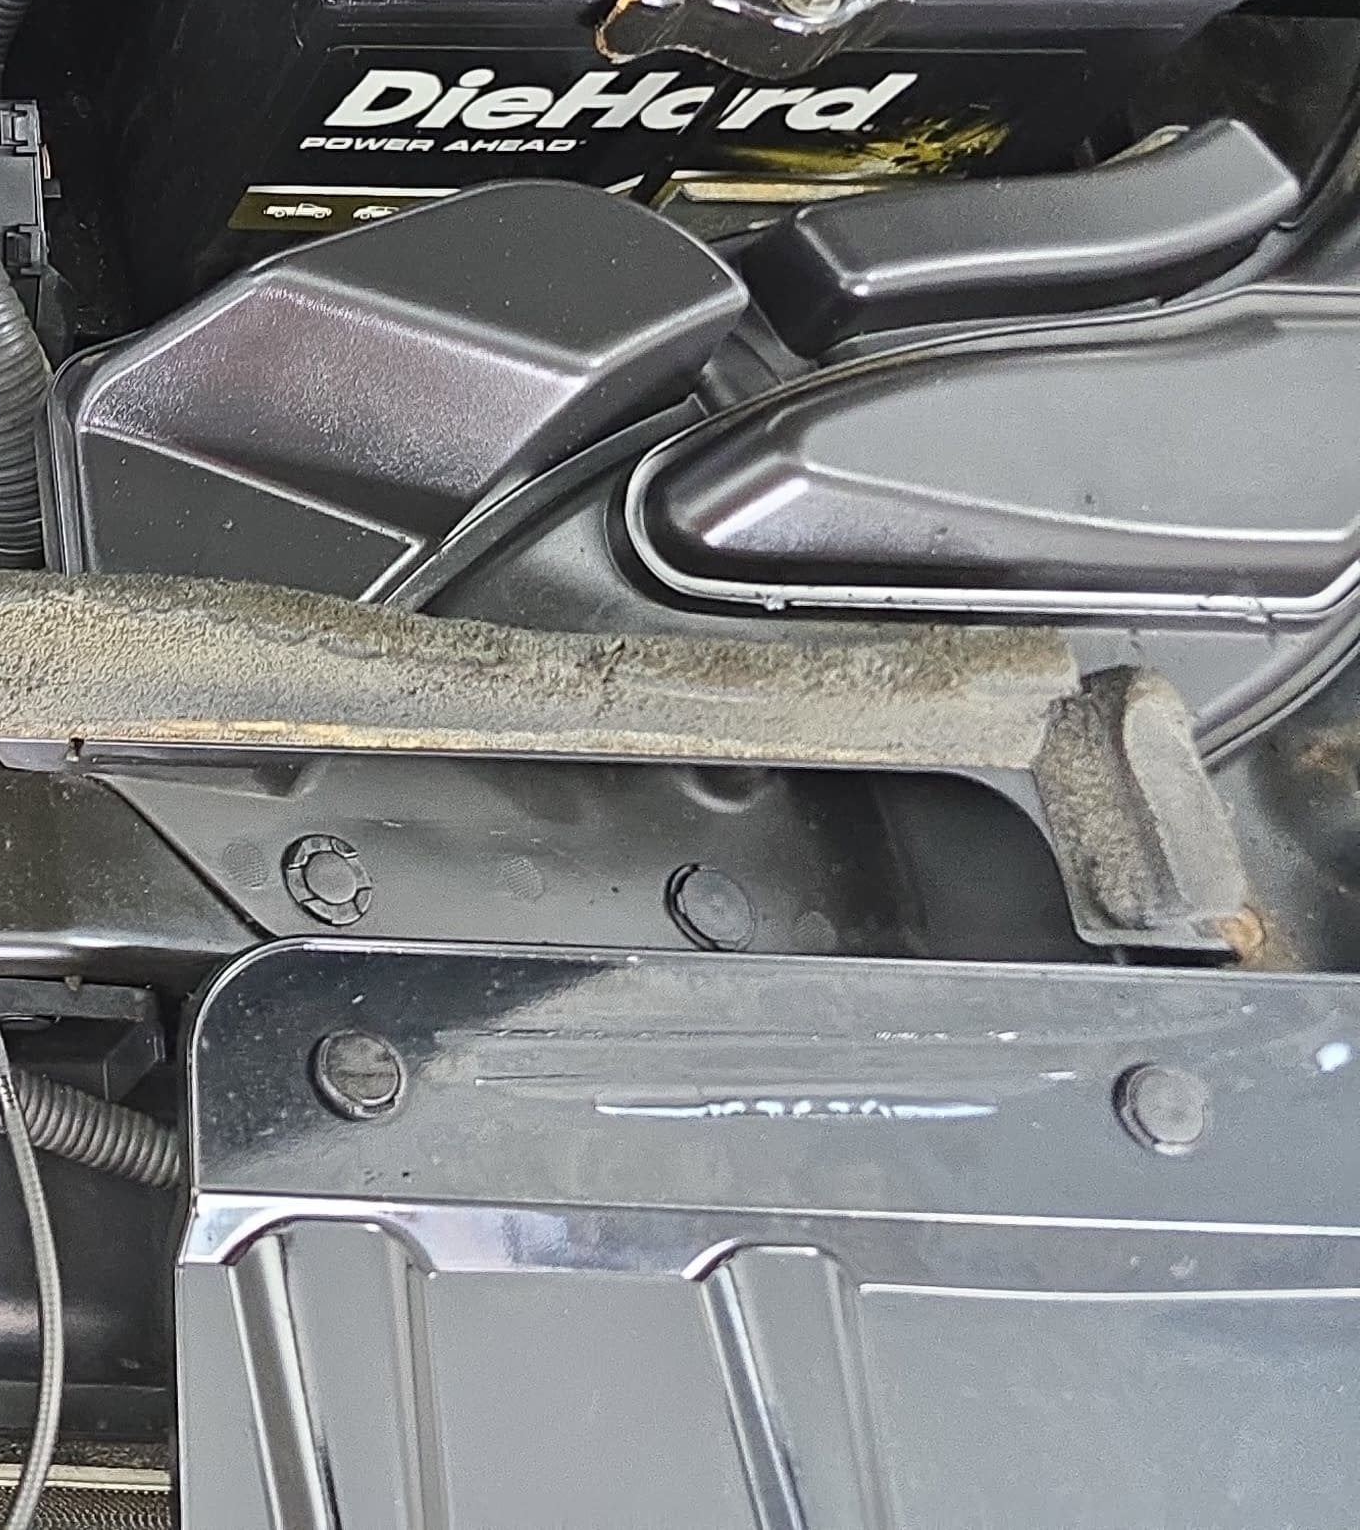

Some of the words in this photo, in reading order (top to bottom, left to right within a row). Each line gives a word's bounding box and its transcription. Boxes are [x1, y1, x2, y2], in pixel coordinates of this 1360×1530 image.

[325, 69, 918, 133] DieHard
[299, 137, 434, 152] POWER
[441, 138, 580, 153] AHEAD
